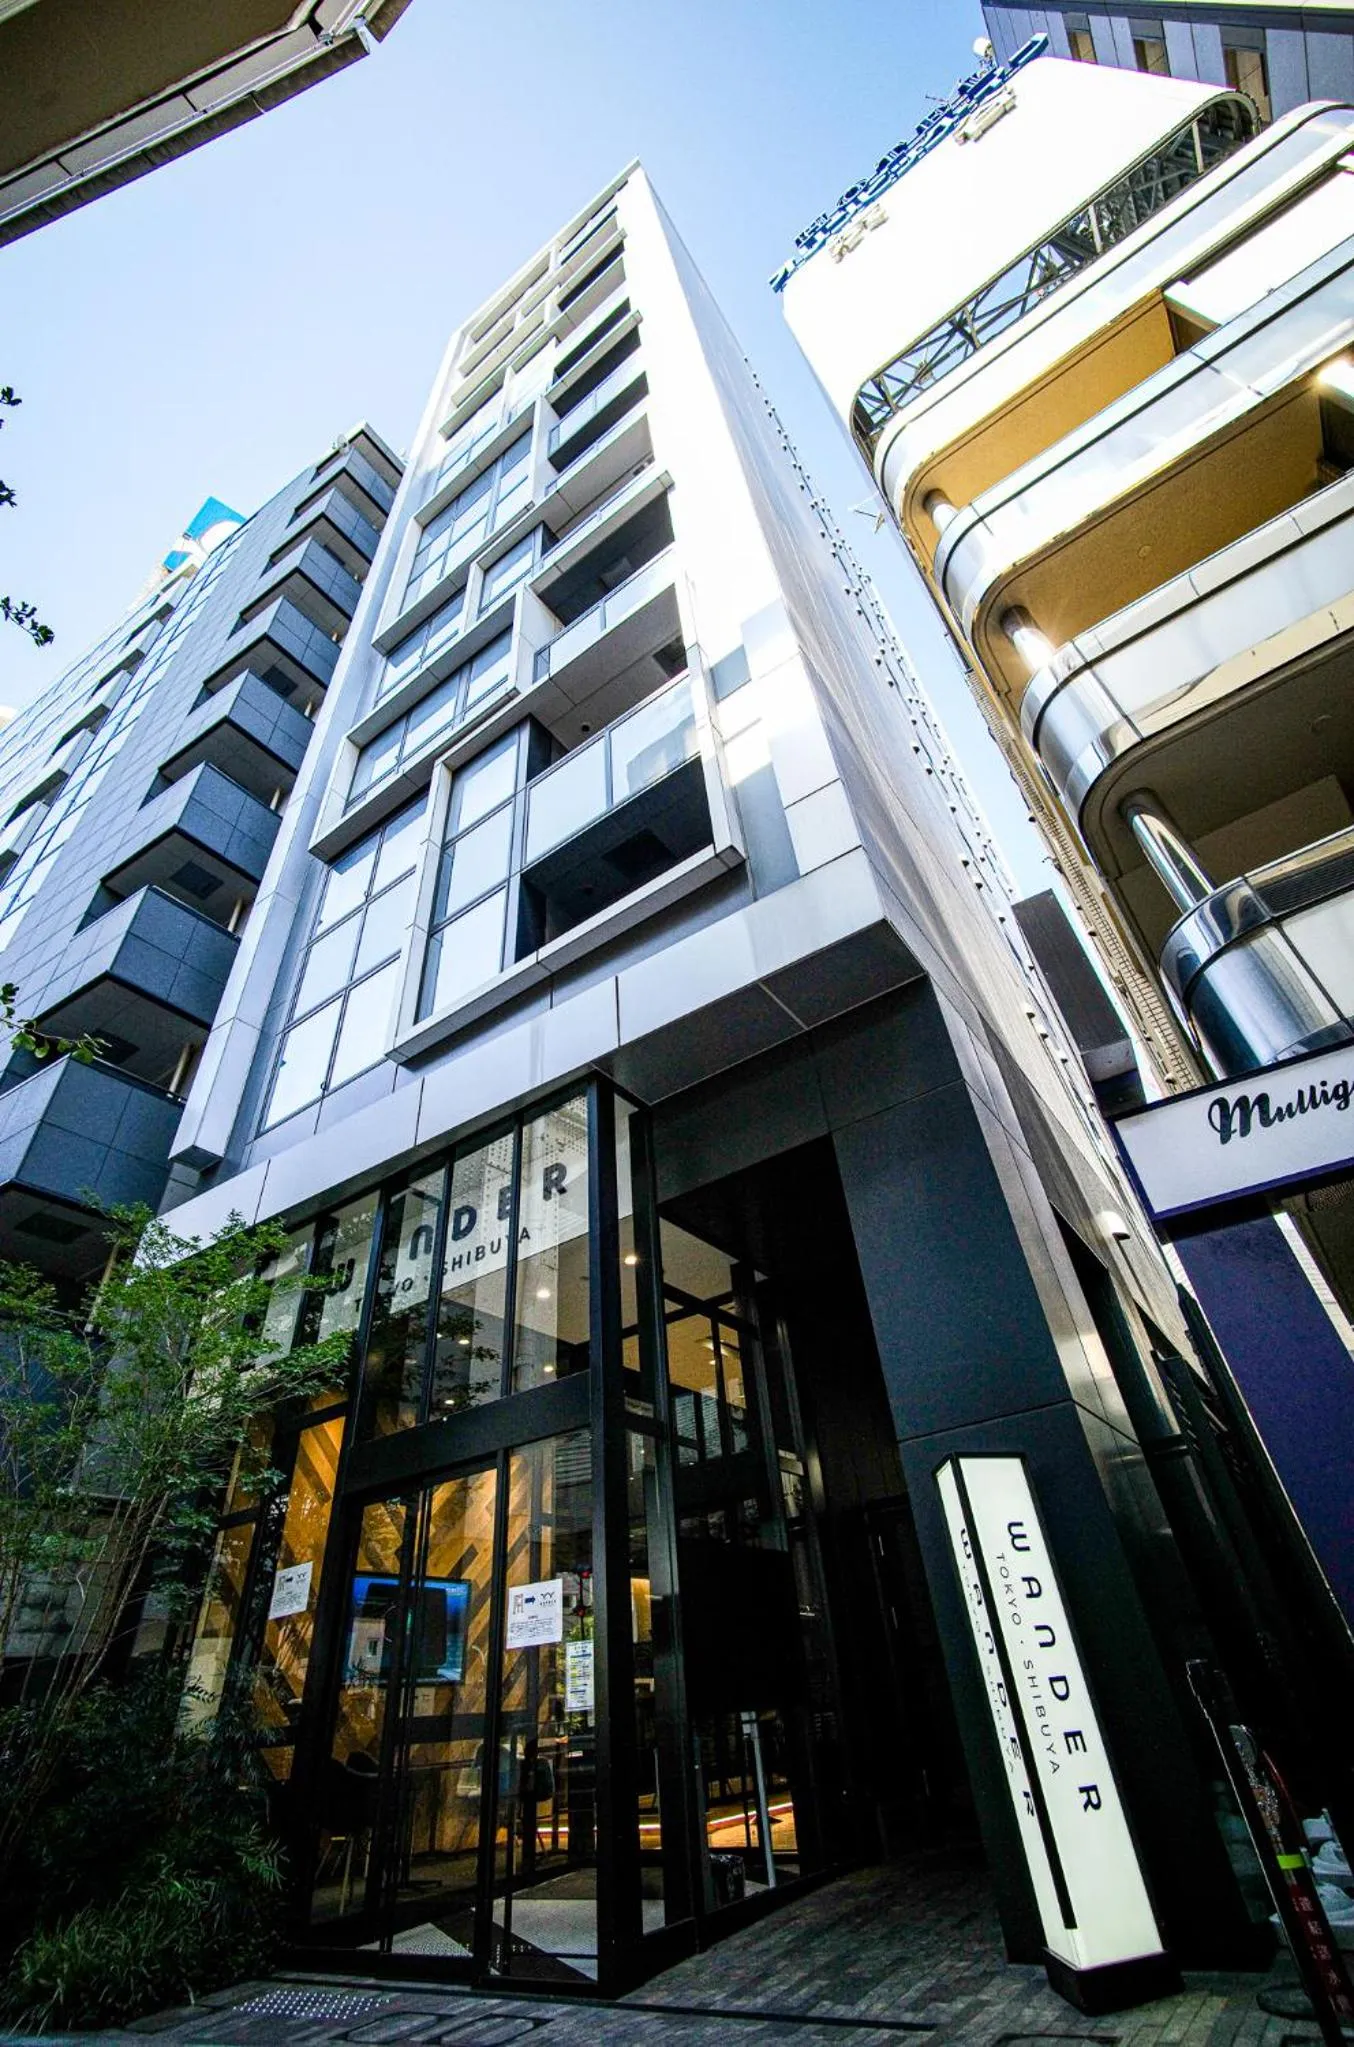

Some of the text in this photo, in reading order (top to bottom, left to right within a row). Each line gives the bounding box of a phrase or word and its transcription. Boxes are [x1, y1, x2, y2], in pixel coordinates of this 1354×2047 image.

[1208, 1080, 1354, 1145] Mullig
[442, 1227, 532, 1276] SHIBUA
[996, 1552, 1060, 1775] TOKYO SHIBUYA
[1007, 1521, 1102, 1812] WANDER
